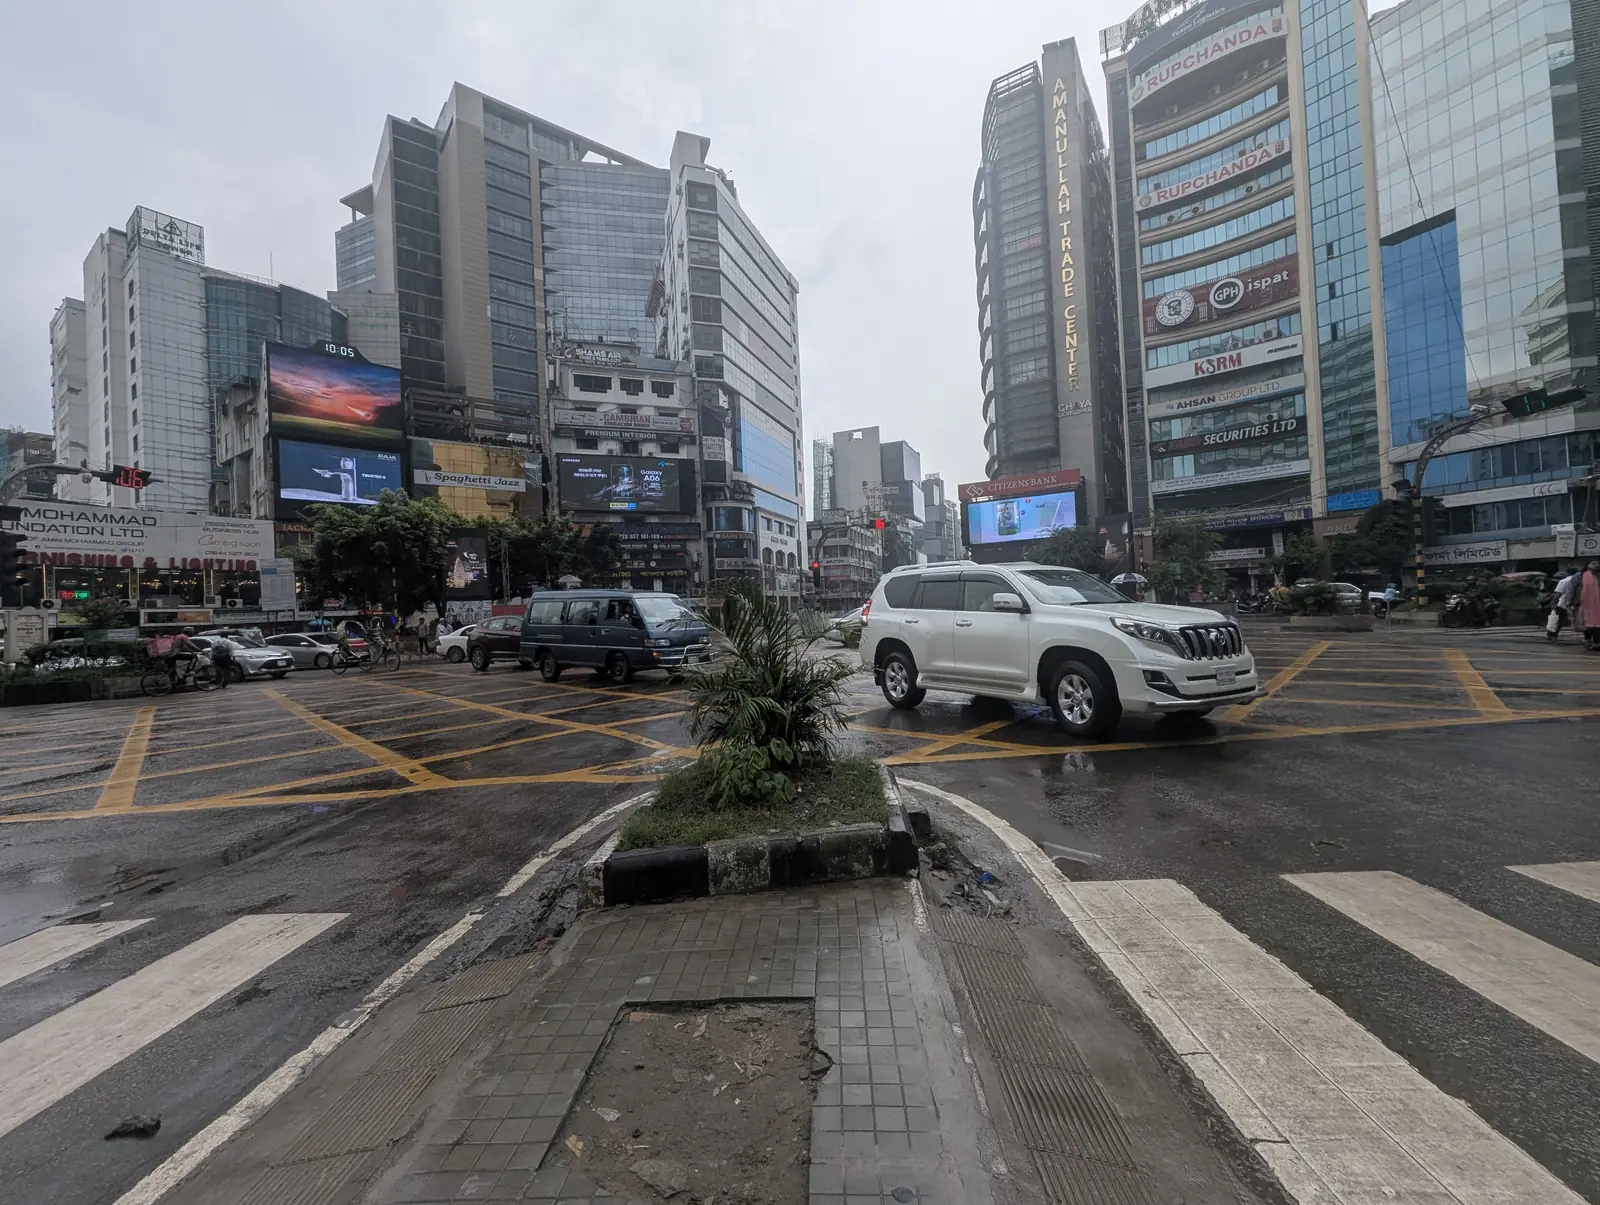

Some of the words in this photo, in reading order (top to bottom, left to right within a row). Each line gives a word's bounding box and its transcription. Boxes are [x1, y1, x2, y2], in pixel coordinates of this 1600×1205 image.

[1147, 24, 1268, 92] RUPCHANDA
[1052, 77, 1072, 215] AMANULLAH
[1156, 148, 1273, 203] RUPCHANDA
[143, 227, 175, 243] DELTA
[178, 238, 202, 252] LIFE
[1059, 221, 1075, 298] TRADE
[1214, 284, 1240, 302] GPH
[1246, 269, 1290, 293] ispat
[325, 343, 355, 357] 10:05
[575, 348, 606, 357] SHAMS
[607, 351, 622, 359] AIR
[1193, 351, 1243, 376] KSRM
[1175, 395, 1217, 411] AHSAN
[1218, 386, 1258, 403] GROUP
[1259, 380, 1283, 394] LTD.
[603, 413, 651, 424] CAMBRIAN
[584, 429, 620, 438] PREMIUM
[621, 431, 657, 440] INTERIOR
[1202, 423, 1269, 446] SECURITIES
[1272, 419, 1297, 434] LTD
[434, 472, 491, 484] Spaghetti
[494, 477, 520, 487] Jazz
[987, 479, 1029, 492] CITIZENS
[1030, 475, 1058, 487] BANK
[23, 506, 157, 527] MOHAMMAD
[0, 521, 105, 537] UNDATION
[110, 527, 148, 539] LTD.
[197, 534, 238, 547] Coming
[64, 538, 114, 546] MOHAMMAD
[24, 551, 134, 568] RNISHING
[143, 553, 158, 570] &
[169, 557, 257, 572] LIGHTING
[1453, 547, 1502, 559] লিমিটেড
